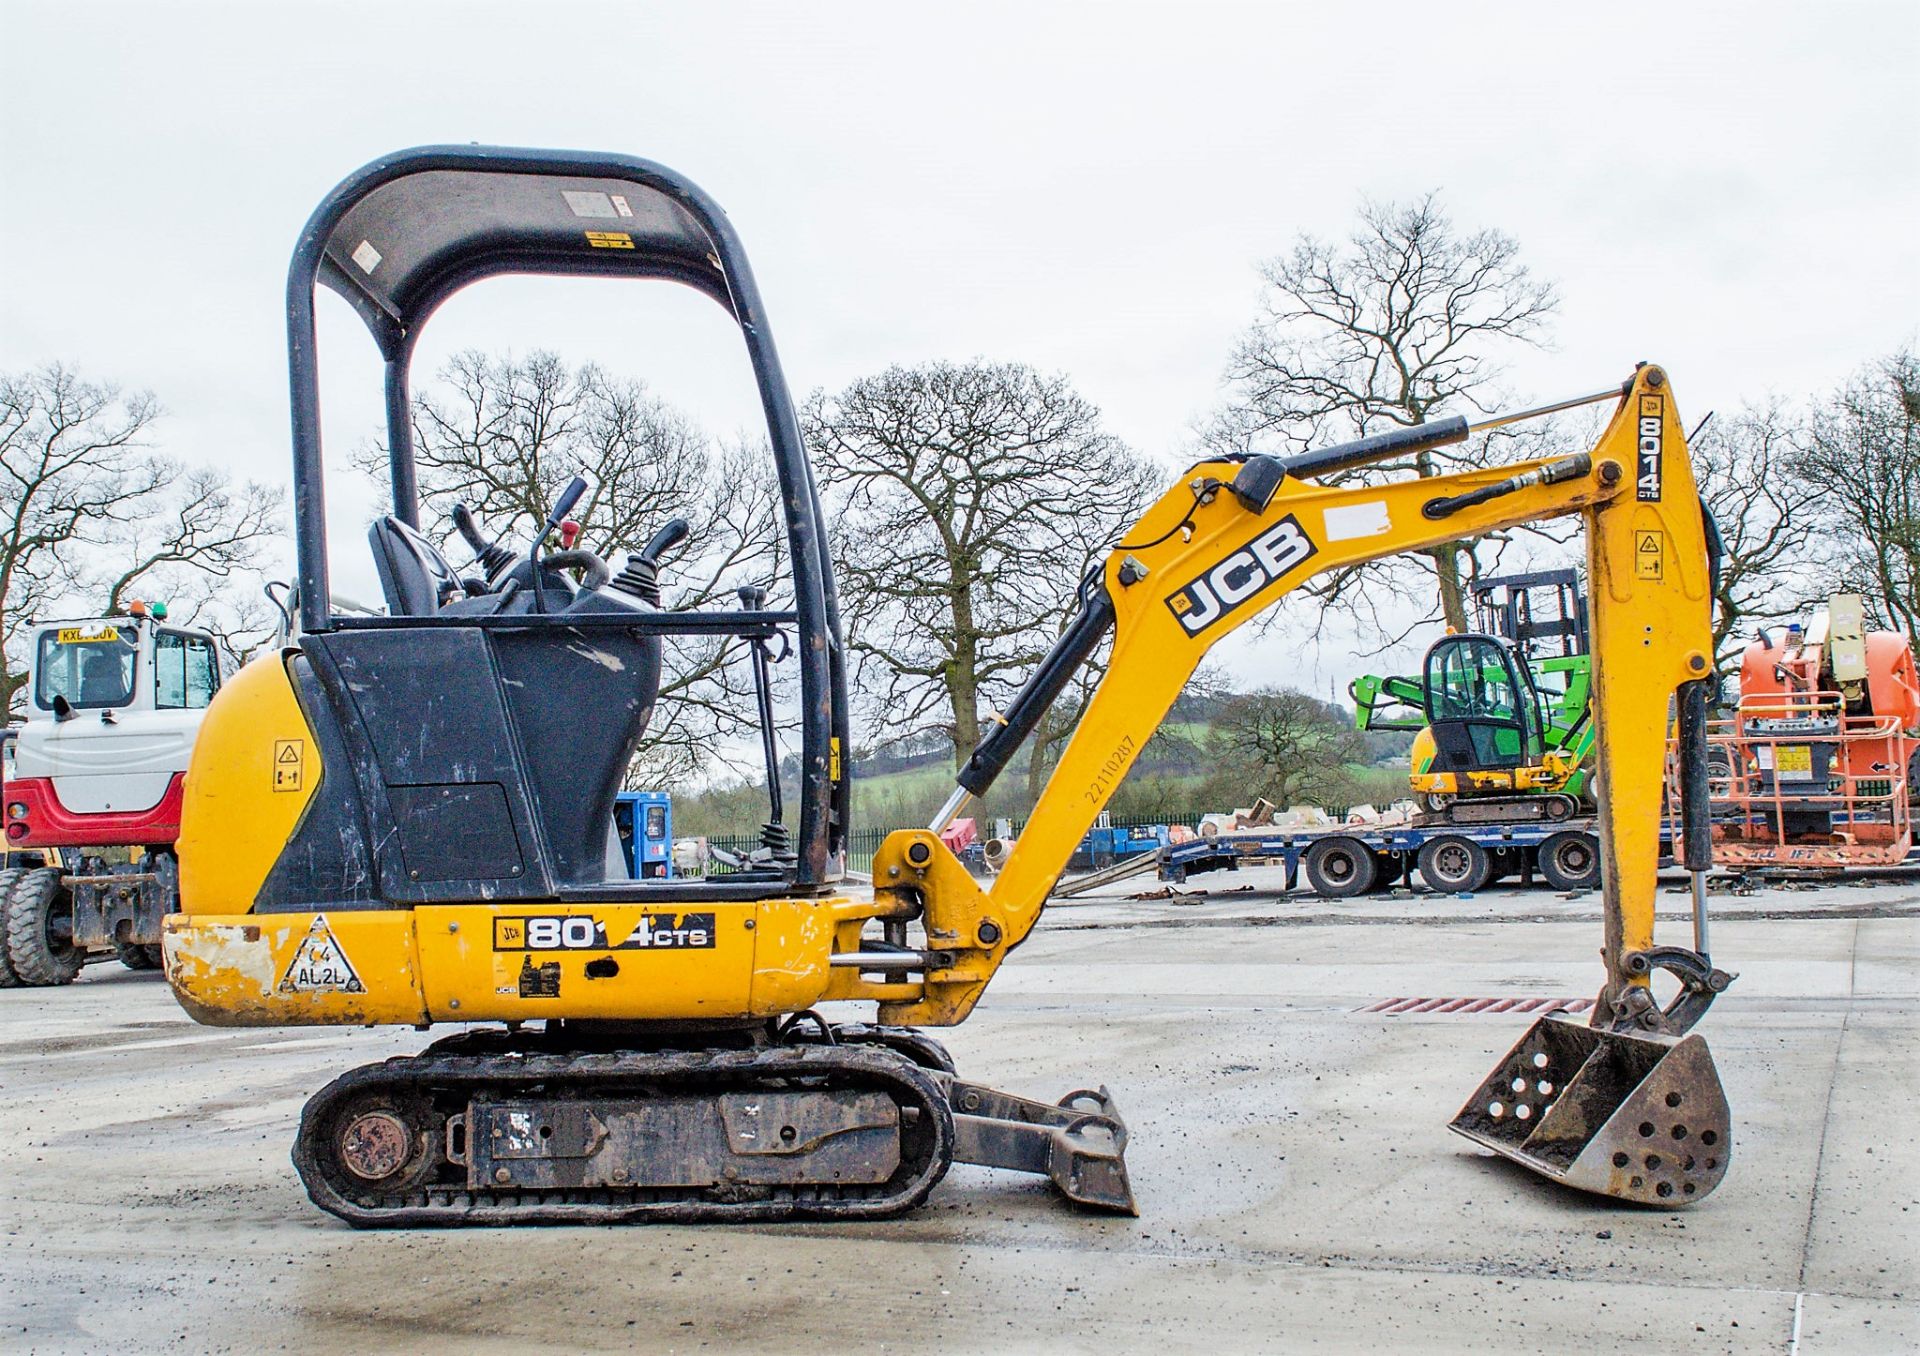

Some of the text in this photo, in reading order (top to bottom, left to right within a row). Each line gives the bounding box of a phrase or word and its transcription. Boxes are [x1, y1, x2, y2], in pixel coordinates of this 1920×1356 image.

[1638, 417, 1661, 492] 8014
[1181, 522, 1310, 630] JCB
[299, 968, 345, 985] AL2L
